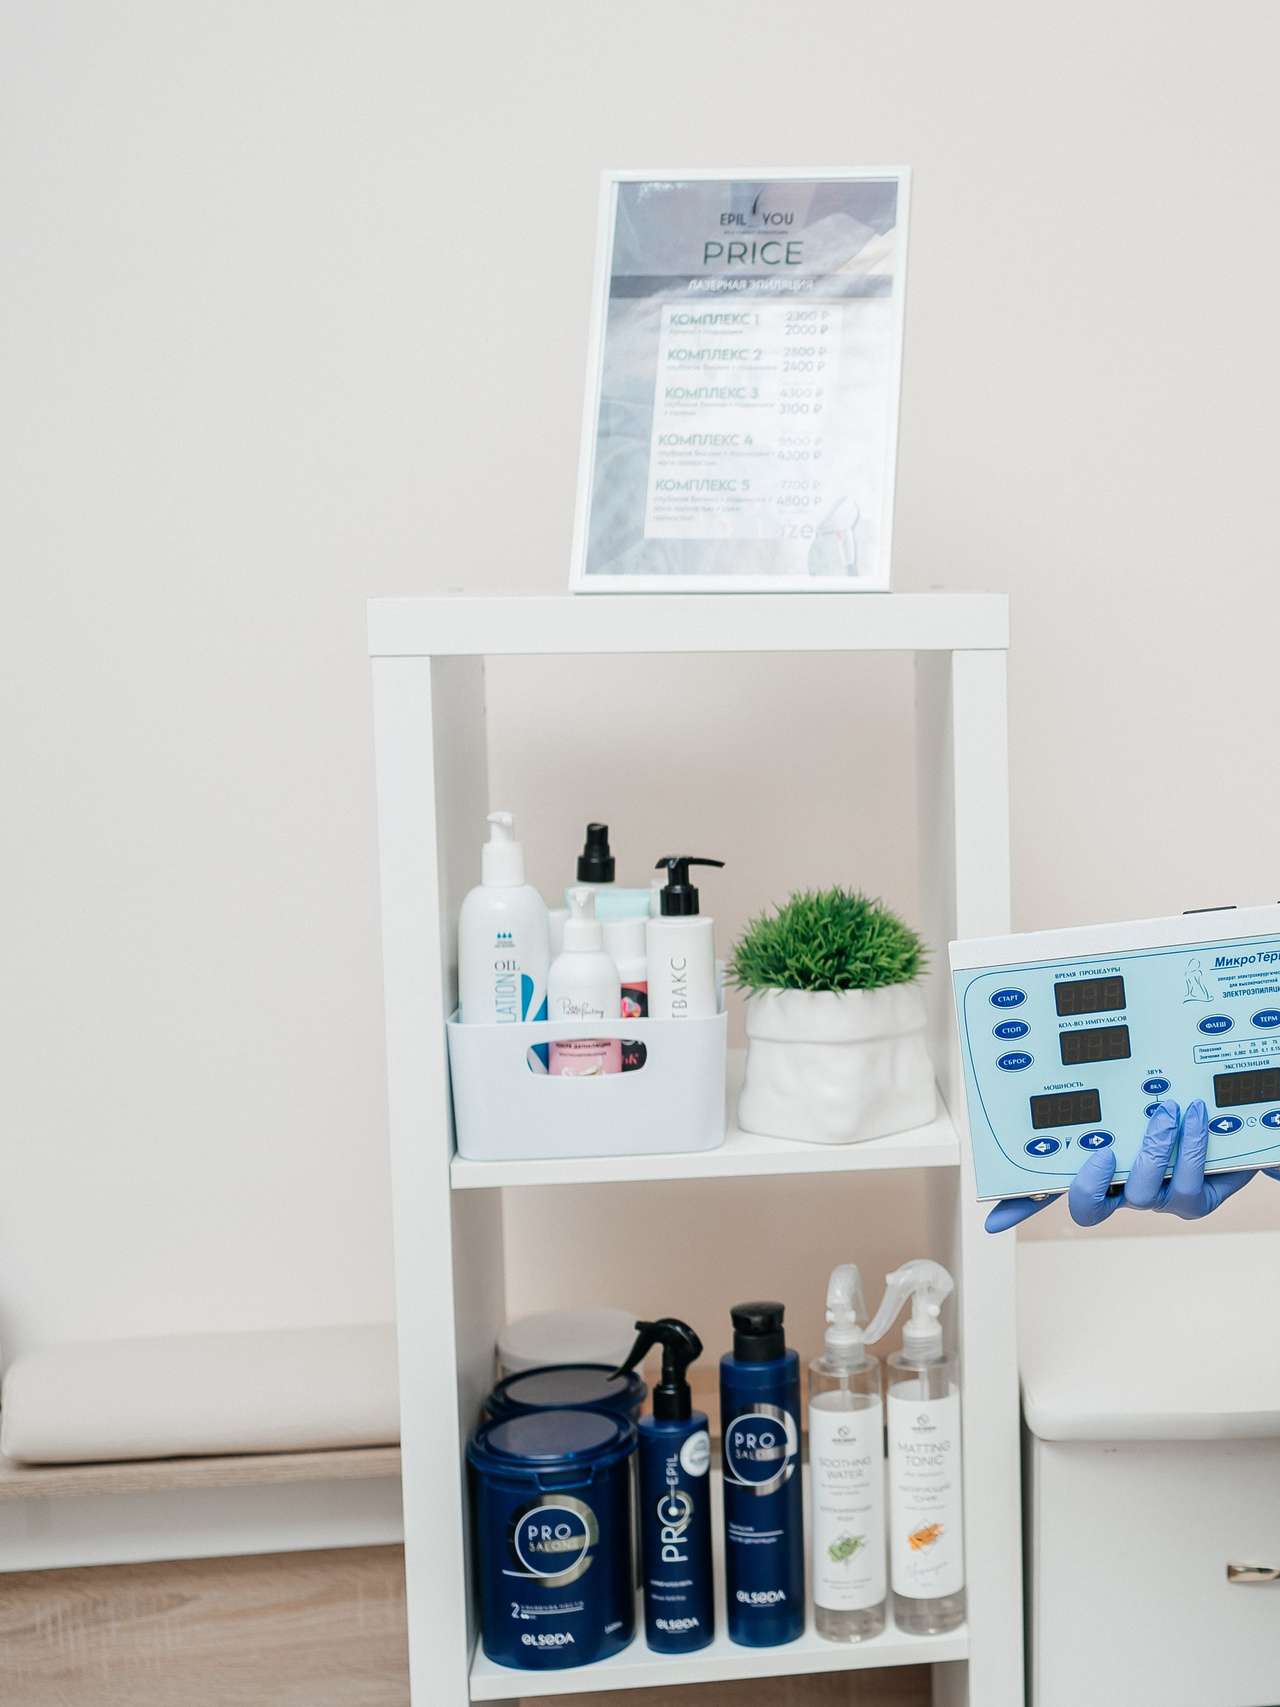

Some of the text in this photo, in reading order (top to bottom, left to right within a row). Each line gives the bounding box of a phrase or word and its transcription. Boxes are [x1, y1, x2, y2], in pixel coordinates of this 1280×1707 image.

[719, 212, 794, 226] EPIL YOU
[703, 240, 803, 265] PRICE
[688, 278, 814, 292] ЛАЗЕРНАЯ ЭПИЛЯЦИЯ
[669, 312, 760, 326] КОМПЛЕКС 1
[784, 324, 816, 335] 2000
[667, 348, 763, 361] КОМПЛЕКС 2
[782, 360, 814, 372] 2400
[664, 387, 759, 399] КОМПЛЕКС 3
[779, 402, 809, 415] 3100
[658, 434, 754, 446] КОМПЛЕКС 4
[655, 479, 750, 492] КОМПЛЕКС 5
[776, 495, 810, 507] 4800
[494, 960, 520, 971] OIL
[1054, 966, 1121, 980] ВРЕМЯ ПРОЦЕДУРЫ
[1239, 977, 1278, 987] высокочастотной
[997, 994, 1019, 1003] СТАРТ
[1058, 1015, 1127, 1028] КОЛ-ВО ИМПУЛЬСОВ
[1205, 1021, 1227, 1029] ФЛЕШ
[1259, 1015, 1278, 1023] ТЕРМ
[1001, 1026, 1022, 1034] СТОП
[1003, 1057, 1027, 1066] СБРОС
[1223, 1059, 1270, 1070] ЭКСПОЗИЦИЯ
[1146, 1068, 1163, 1076] ЗВУК
[1043, 1081, 1084, 1091] МОЩНОСТЬ
[734, 1432, 776, 1449] PRO
[897, 1440, 951, 1454] MATTING
[734, 1448, 776, 1460] SALON
[818, 1456, 872, 1469] SOOTHING
[905, 1454, 945, 1468] TONIC
[665, 1453, 679, 1485] EPIL
[825, 1469, 864, 1480] WATER
[527, 1523, 572, 1541] PRO
[528, 1540, 573, 1553] SALON
[511, 1602, 520, 1619] 2
